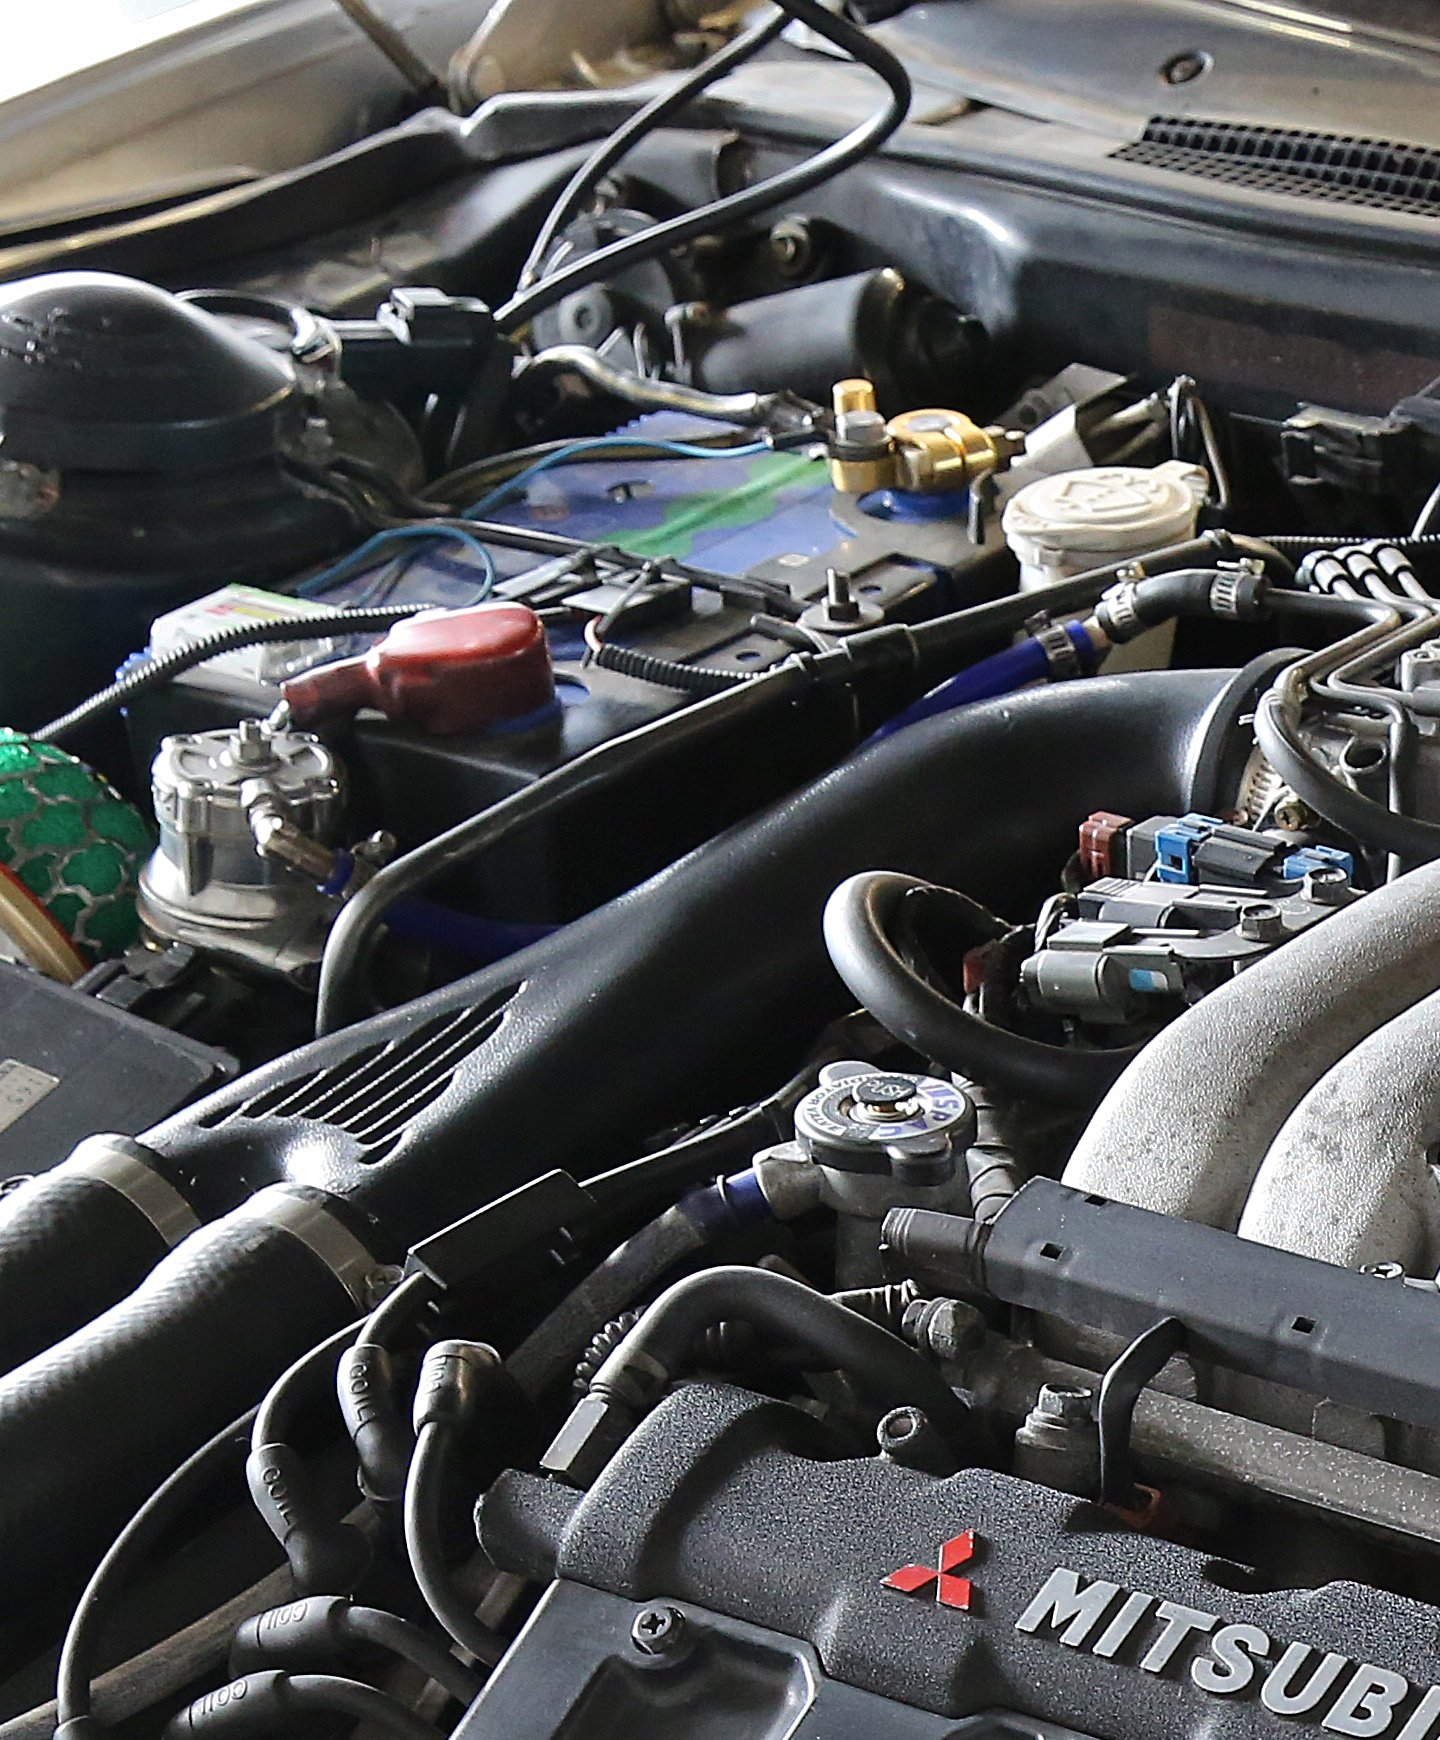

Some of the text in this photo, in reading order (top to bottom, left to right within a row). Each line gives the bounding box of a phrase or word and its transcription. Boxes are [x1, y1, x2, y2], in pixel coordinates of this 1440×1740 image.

[350, 1364, 375, 1422] COIL
[260, 1468, 295, 1526] COIL
[267, 1601, 309, 1630] COIL
[199, 1679, 249, 1715] COIL
